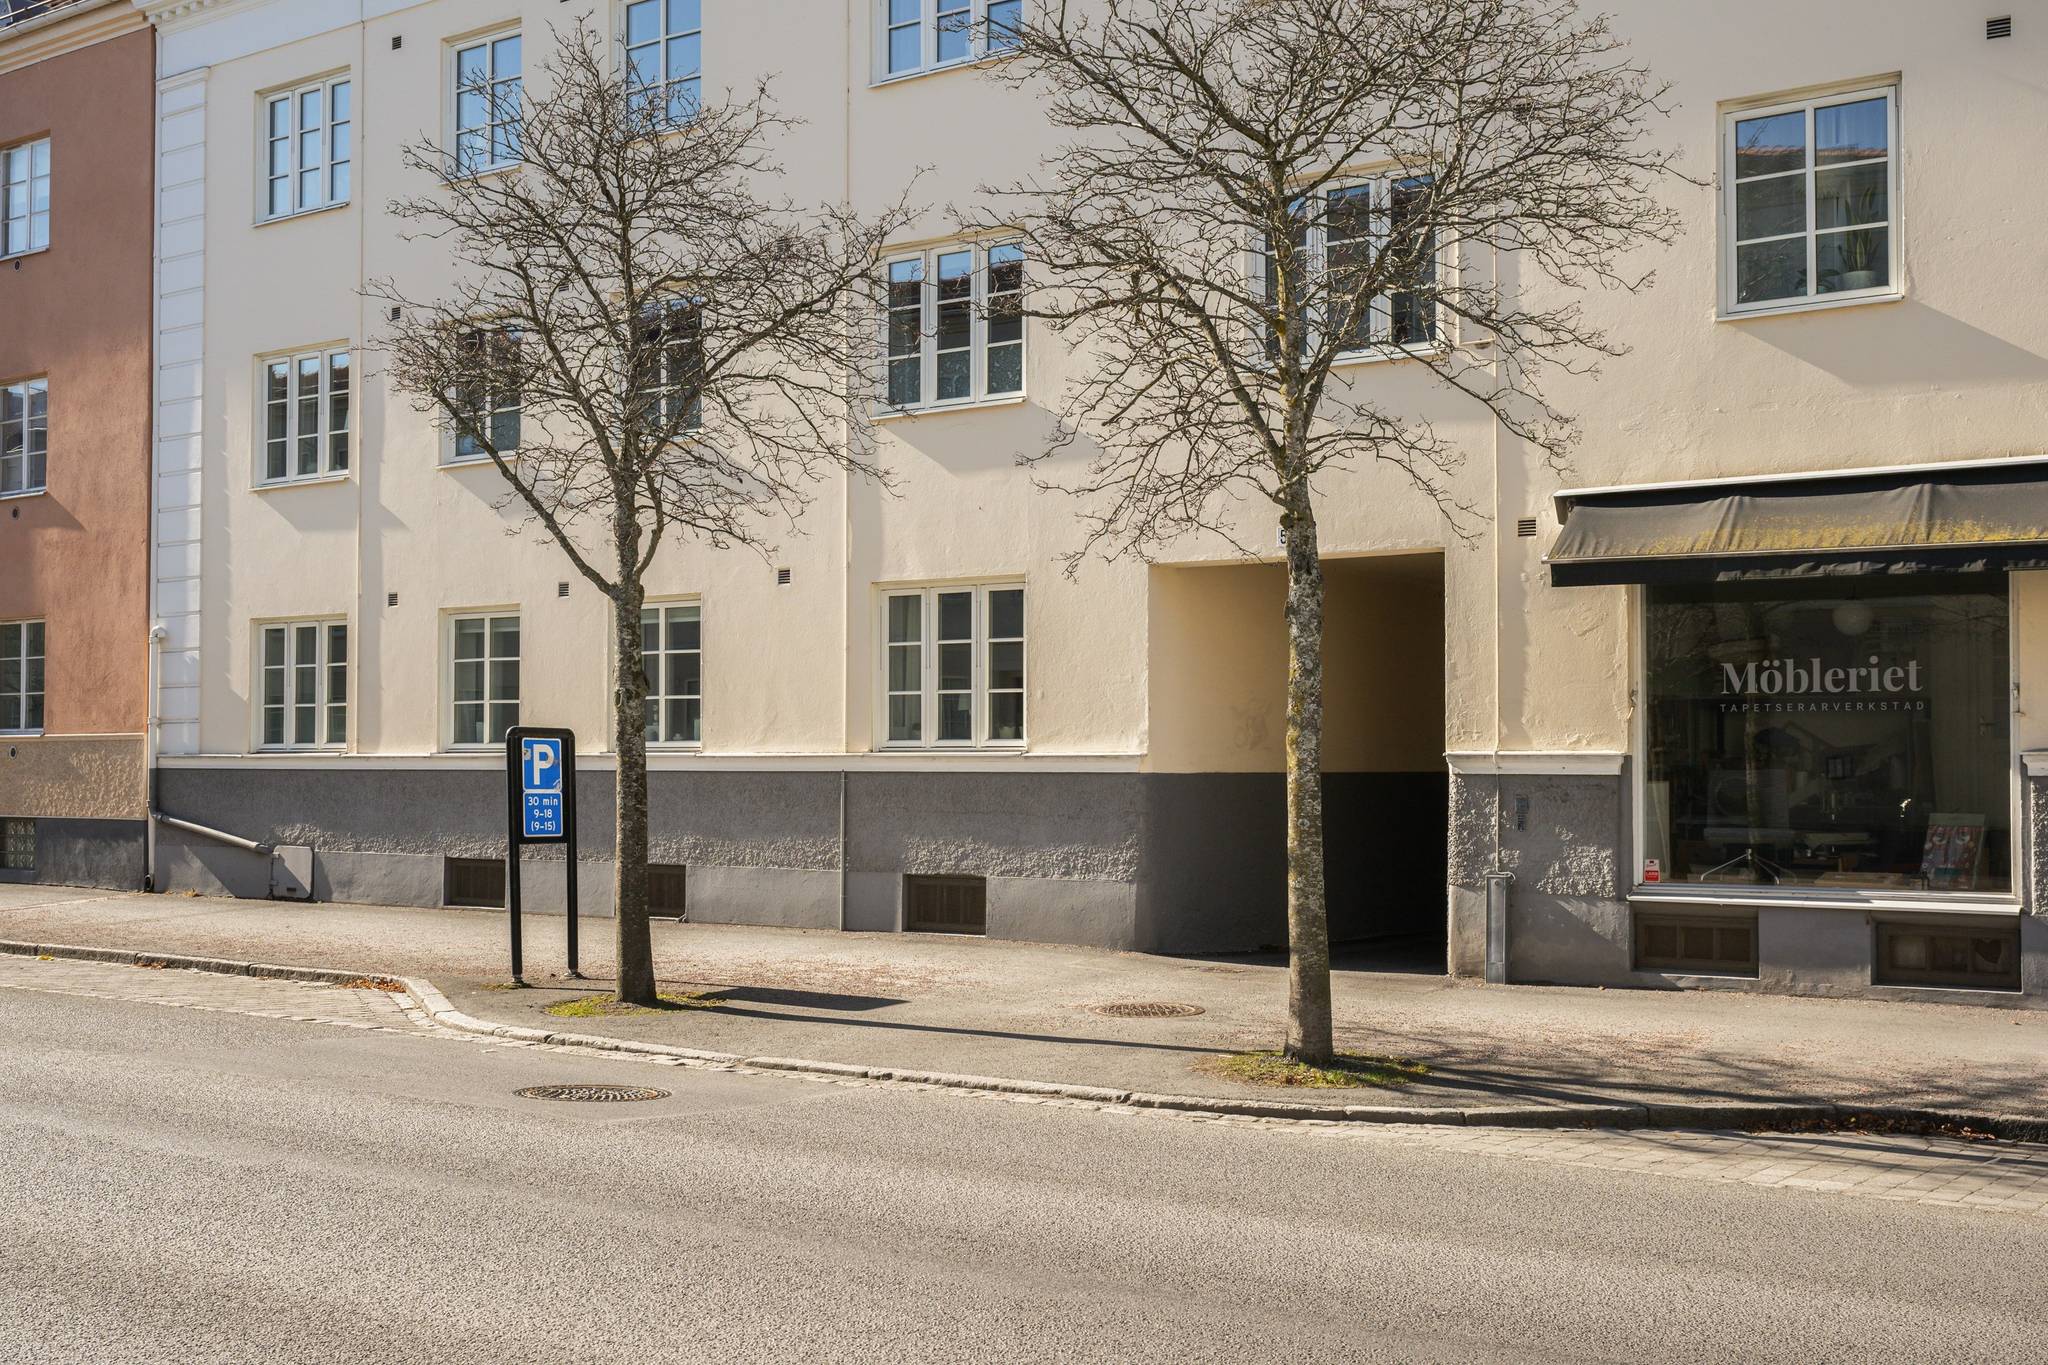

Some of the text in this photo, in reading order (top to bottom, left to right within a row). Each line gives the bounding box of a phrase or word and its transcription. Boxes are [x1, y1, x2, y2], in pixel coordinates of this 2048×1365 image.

[1720, 655, 1924, 694] Möbleriet
[1720, 701, 1925, 713] TAPETSERARVERKSTAD
[533, 743, 554, 785] P
[528, 796, 558, 806] 30 min
[533, 808, 553, 819] 9-18
[531, 821, 556, 832] (9-15)
